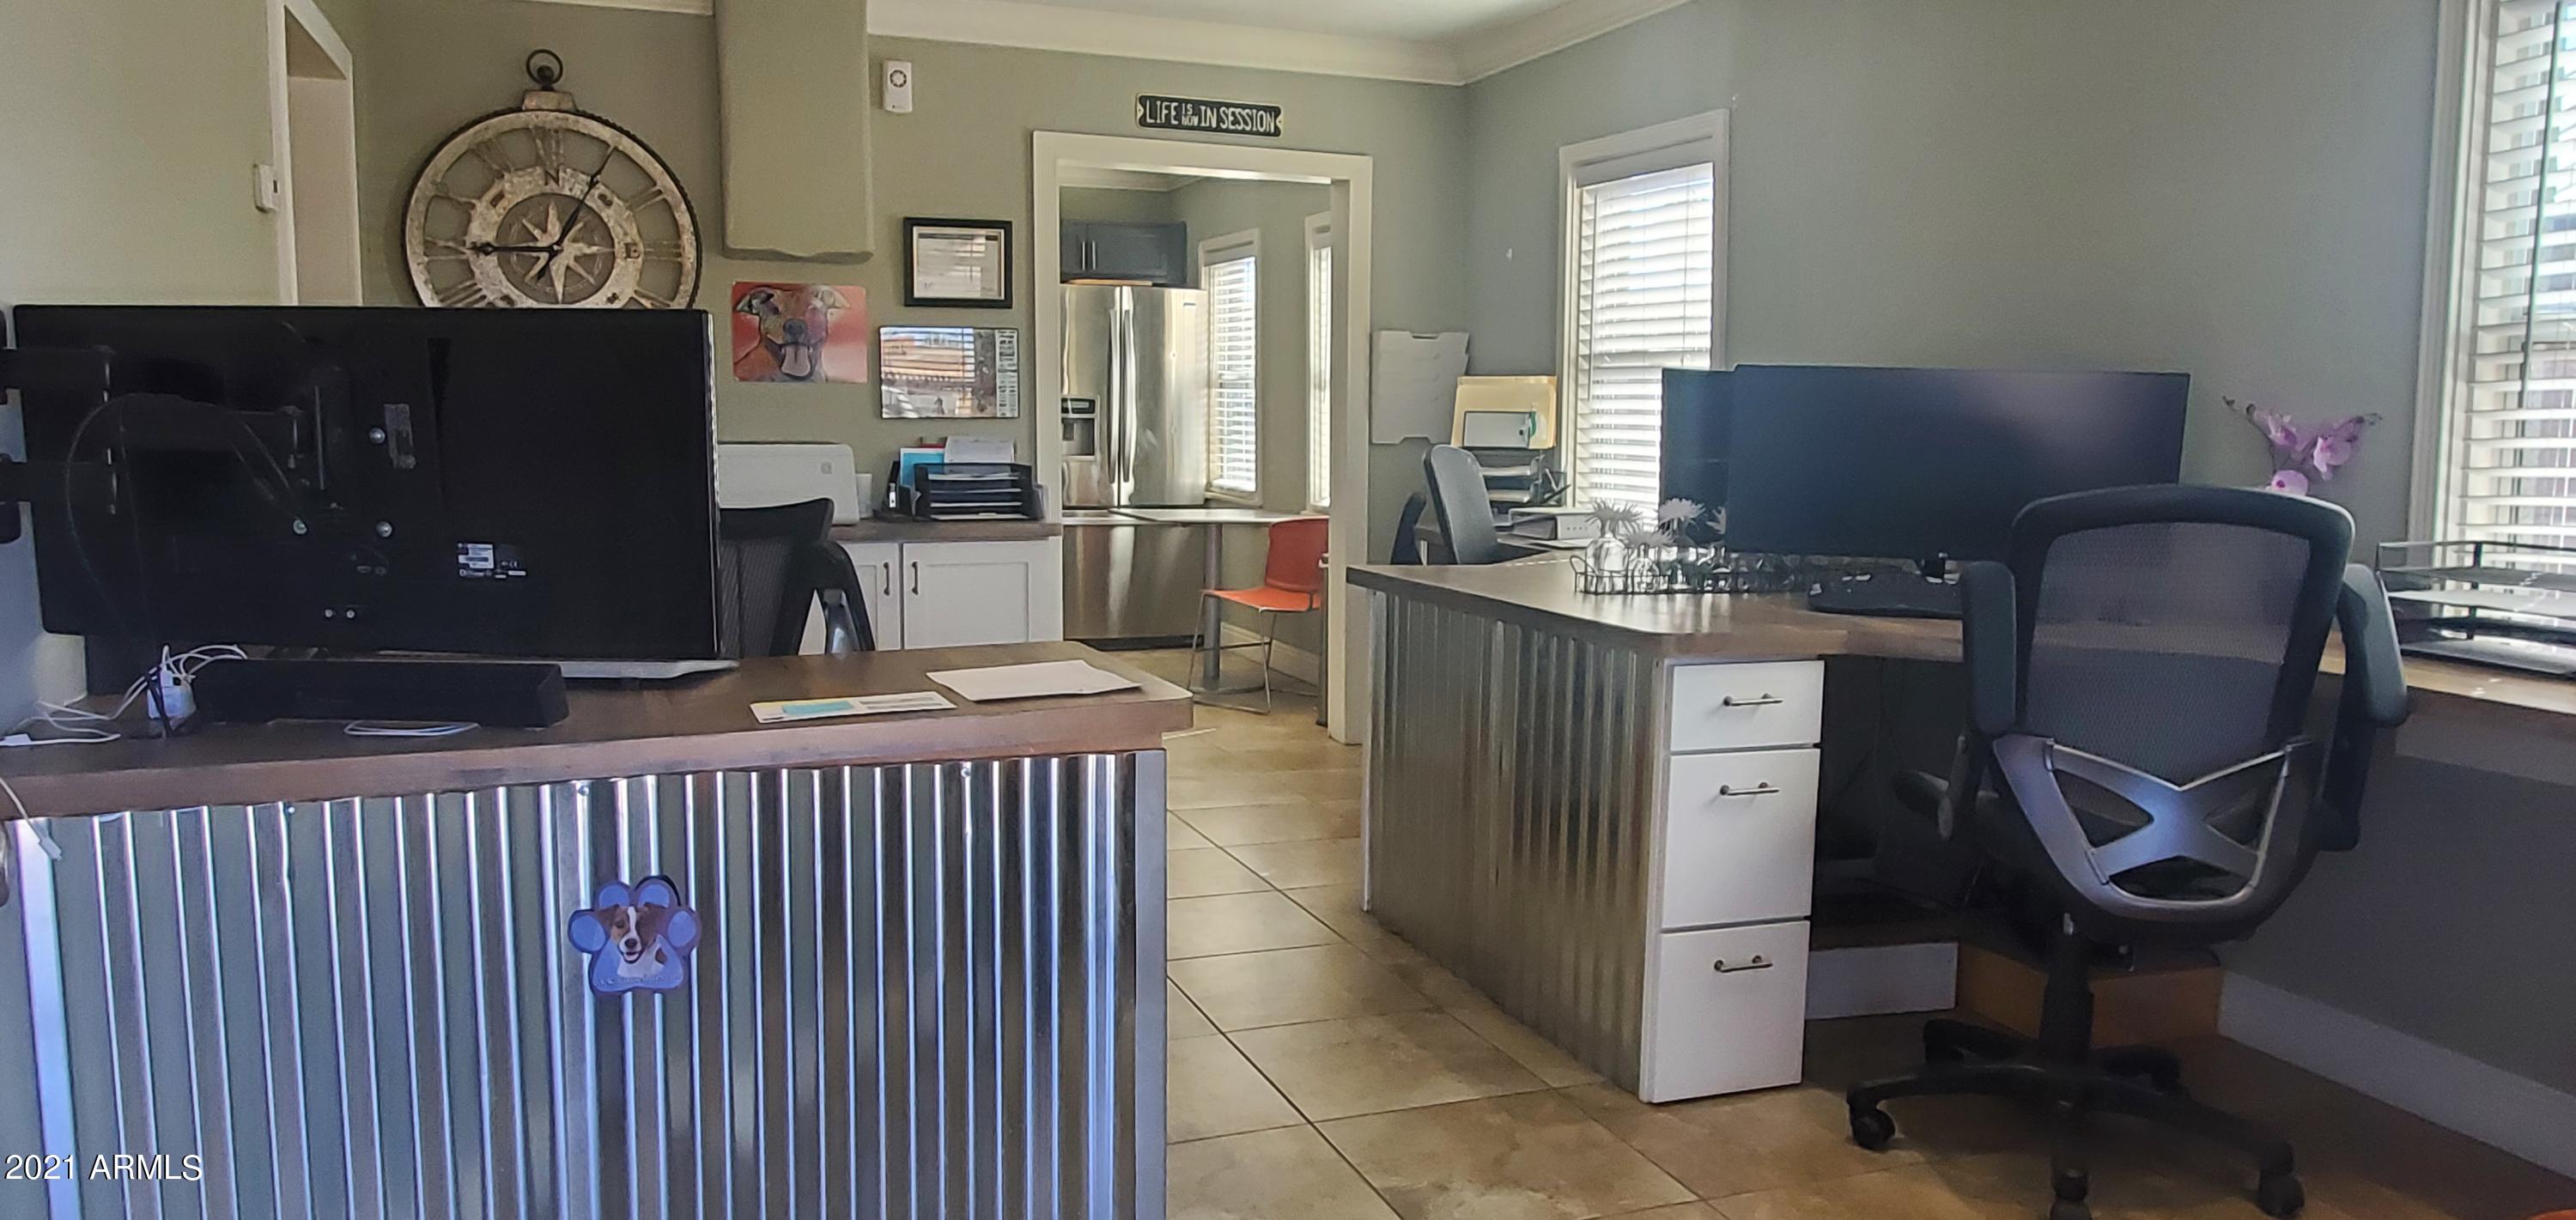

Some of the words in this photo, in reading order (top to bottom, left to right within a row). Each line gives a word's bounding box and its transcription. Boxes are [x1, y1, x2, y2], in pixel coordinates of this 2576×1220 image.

[1145, 100, 1179, 124] LIFE
[1182, 103, 1193, 114] IS
[1200, 106, 1218, 128] IN
[1219, 106, 1275, 133] SESSION
